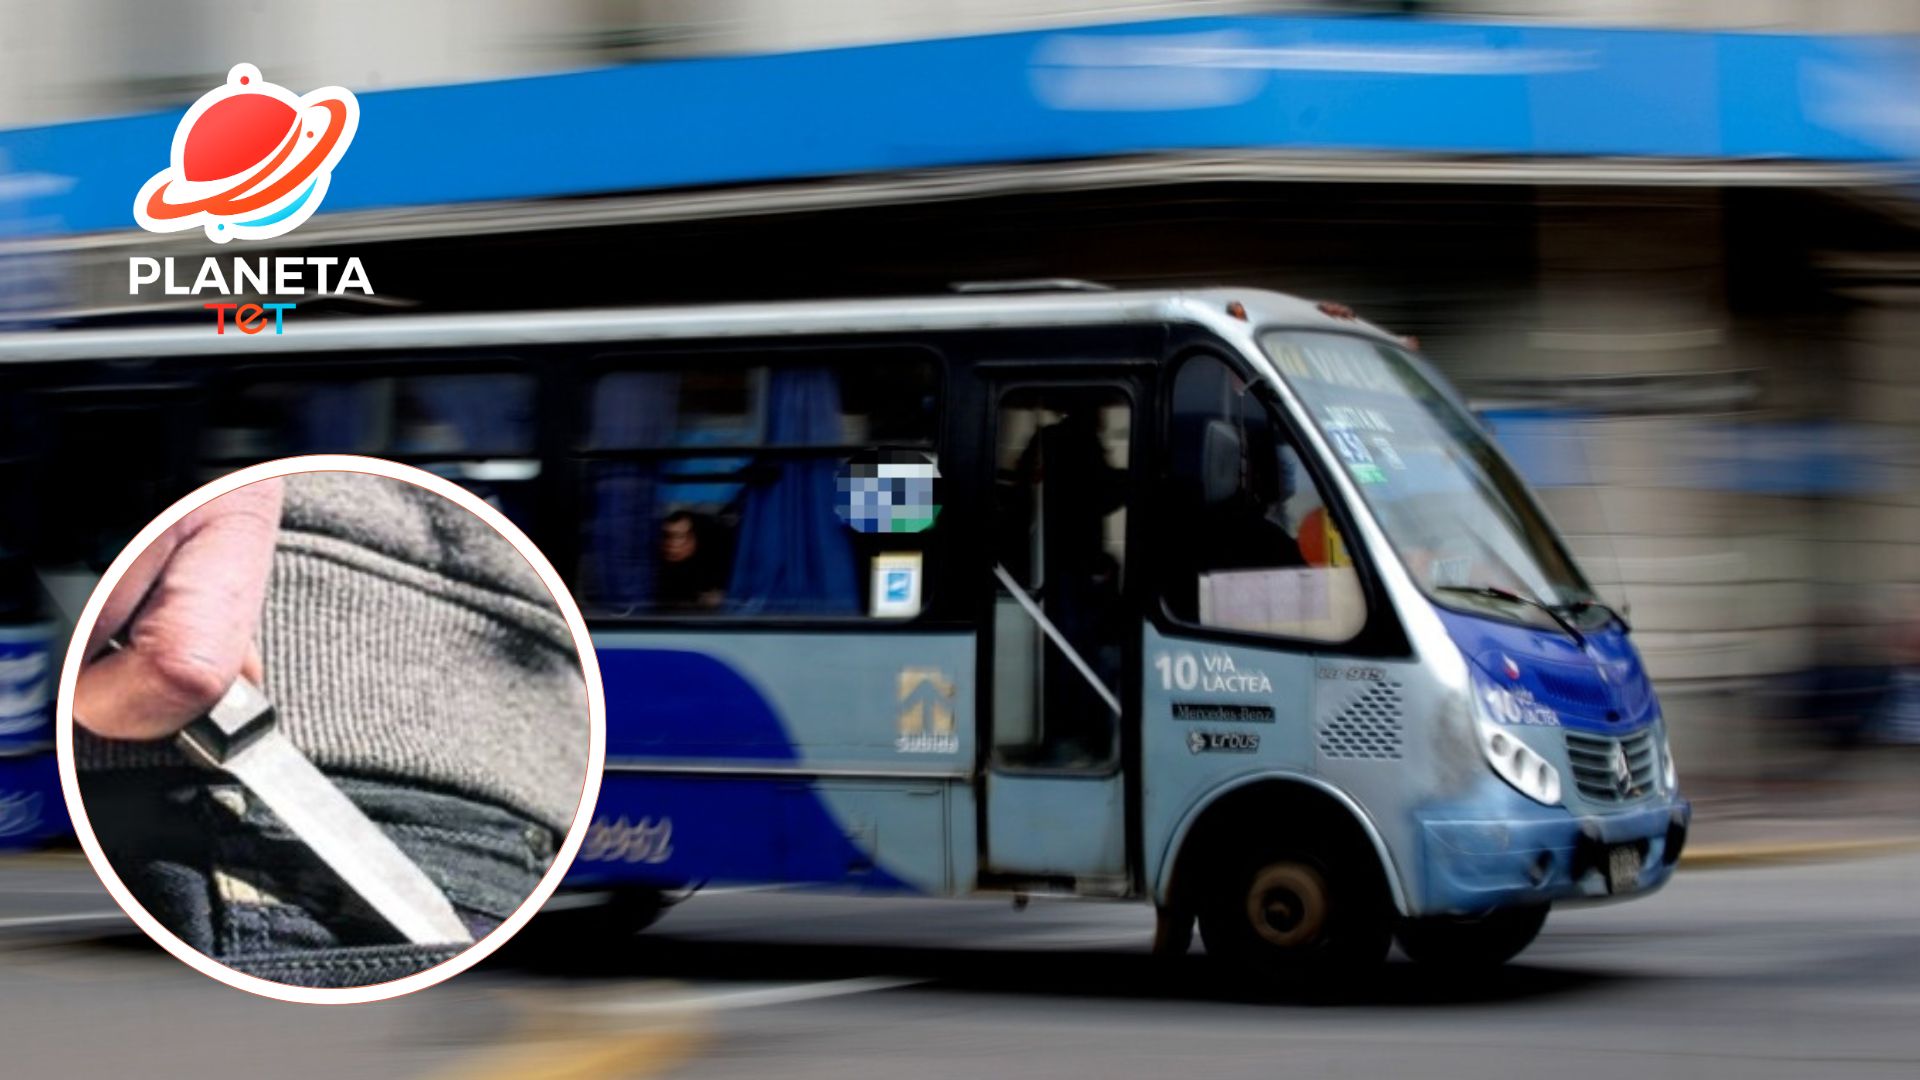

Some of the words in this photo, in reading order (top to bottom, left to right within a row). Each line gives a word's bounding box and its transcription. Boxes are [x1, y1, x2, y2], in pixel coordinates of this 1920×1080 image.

[1155, 654, 1198, 690] 10
[1202, 653, 1235, 673] VIA
[1203, 672, 1272, 693] LACTEA
[1178, 705, 1272, 720] Mercedes-Benz
